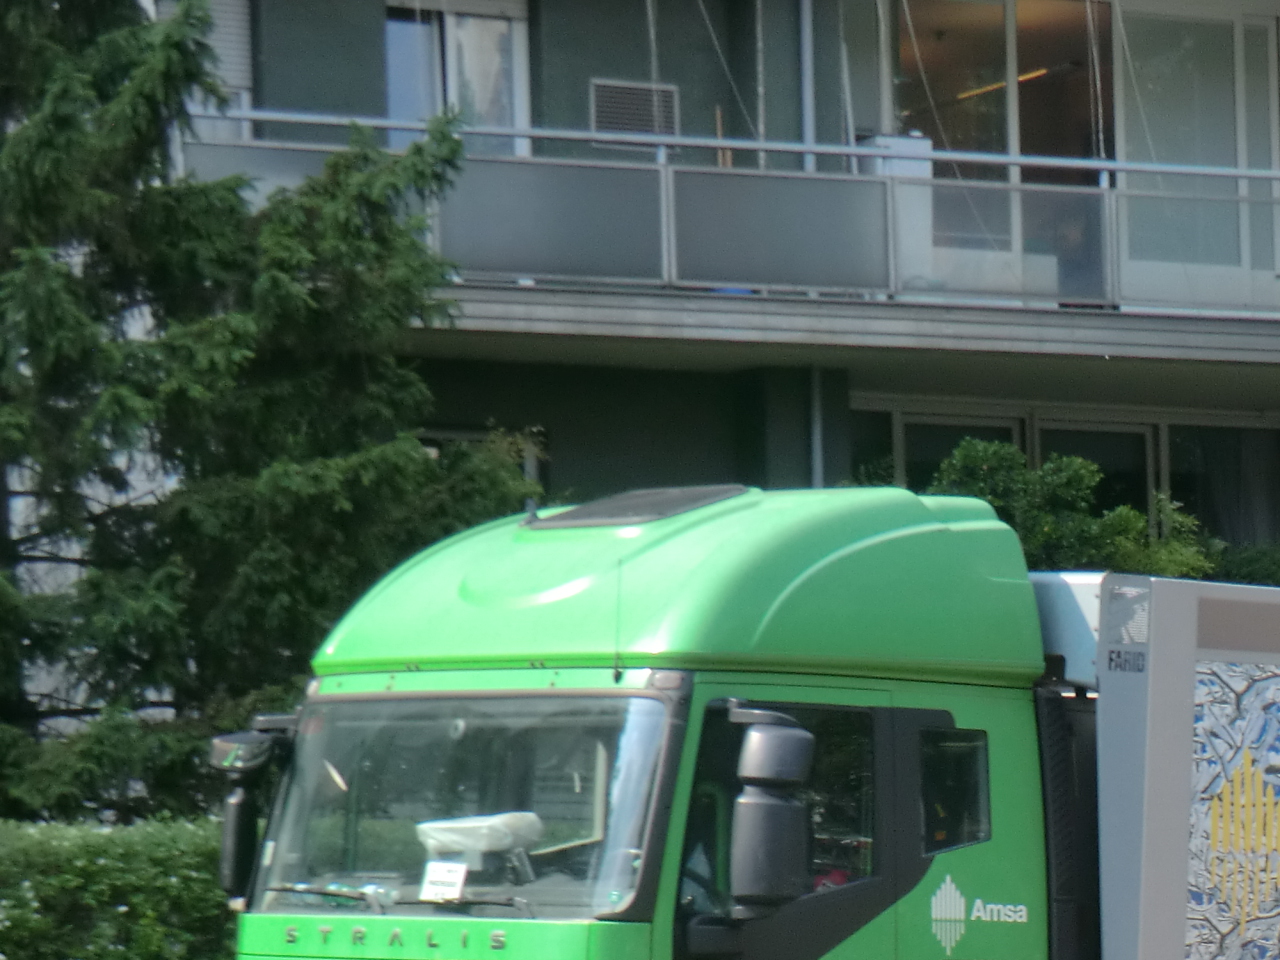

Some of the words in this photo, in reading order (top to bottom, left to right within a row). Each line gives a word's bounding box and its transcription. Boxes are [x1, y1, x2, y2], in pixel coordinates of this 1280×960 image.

[1108, 648, 1146, 673] FARID
[970, 898, 1028, 923] Amsa
[284, 926, 507, 950] STRALIS
